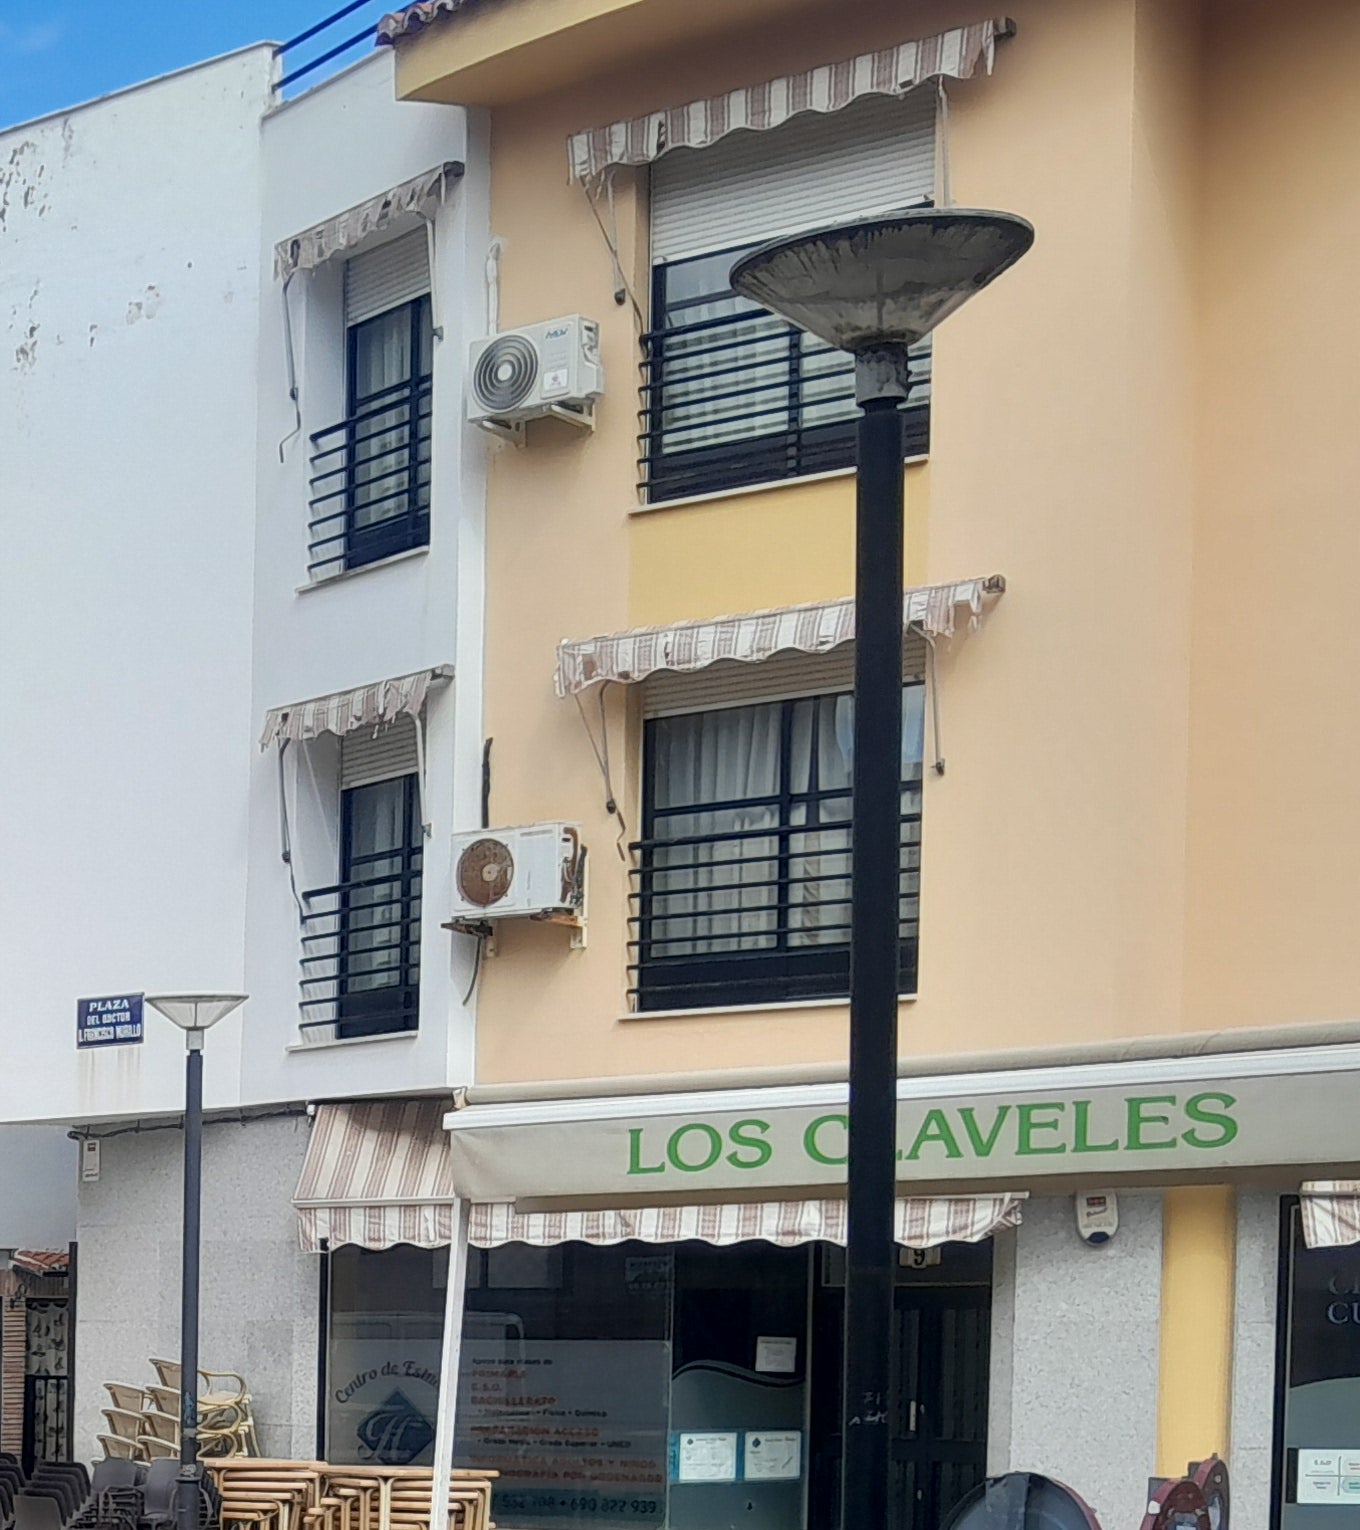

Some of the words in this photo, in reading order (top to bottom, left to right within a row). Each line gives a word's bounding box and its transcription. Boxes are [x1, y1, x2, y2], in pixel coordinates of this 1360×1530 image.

[89, 999, 130, 1012] PLAZA
[87, 1015, 100, 1026] DEL
[626, 1119, 773, 1176] LOS
[803, 1092, 1240, 1167] CAVELES
[913, 1248, 927, 1267] 9
[334, 1367, 378, 1404] Centro
[380, 1361, 399, 1376] de
[570, 1498, 598, 1512] 690
[630, 1500, 658, 1515] 939
